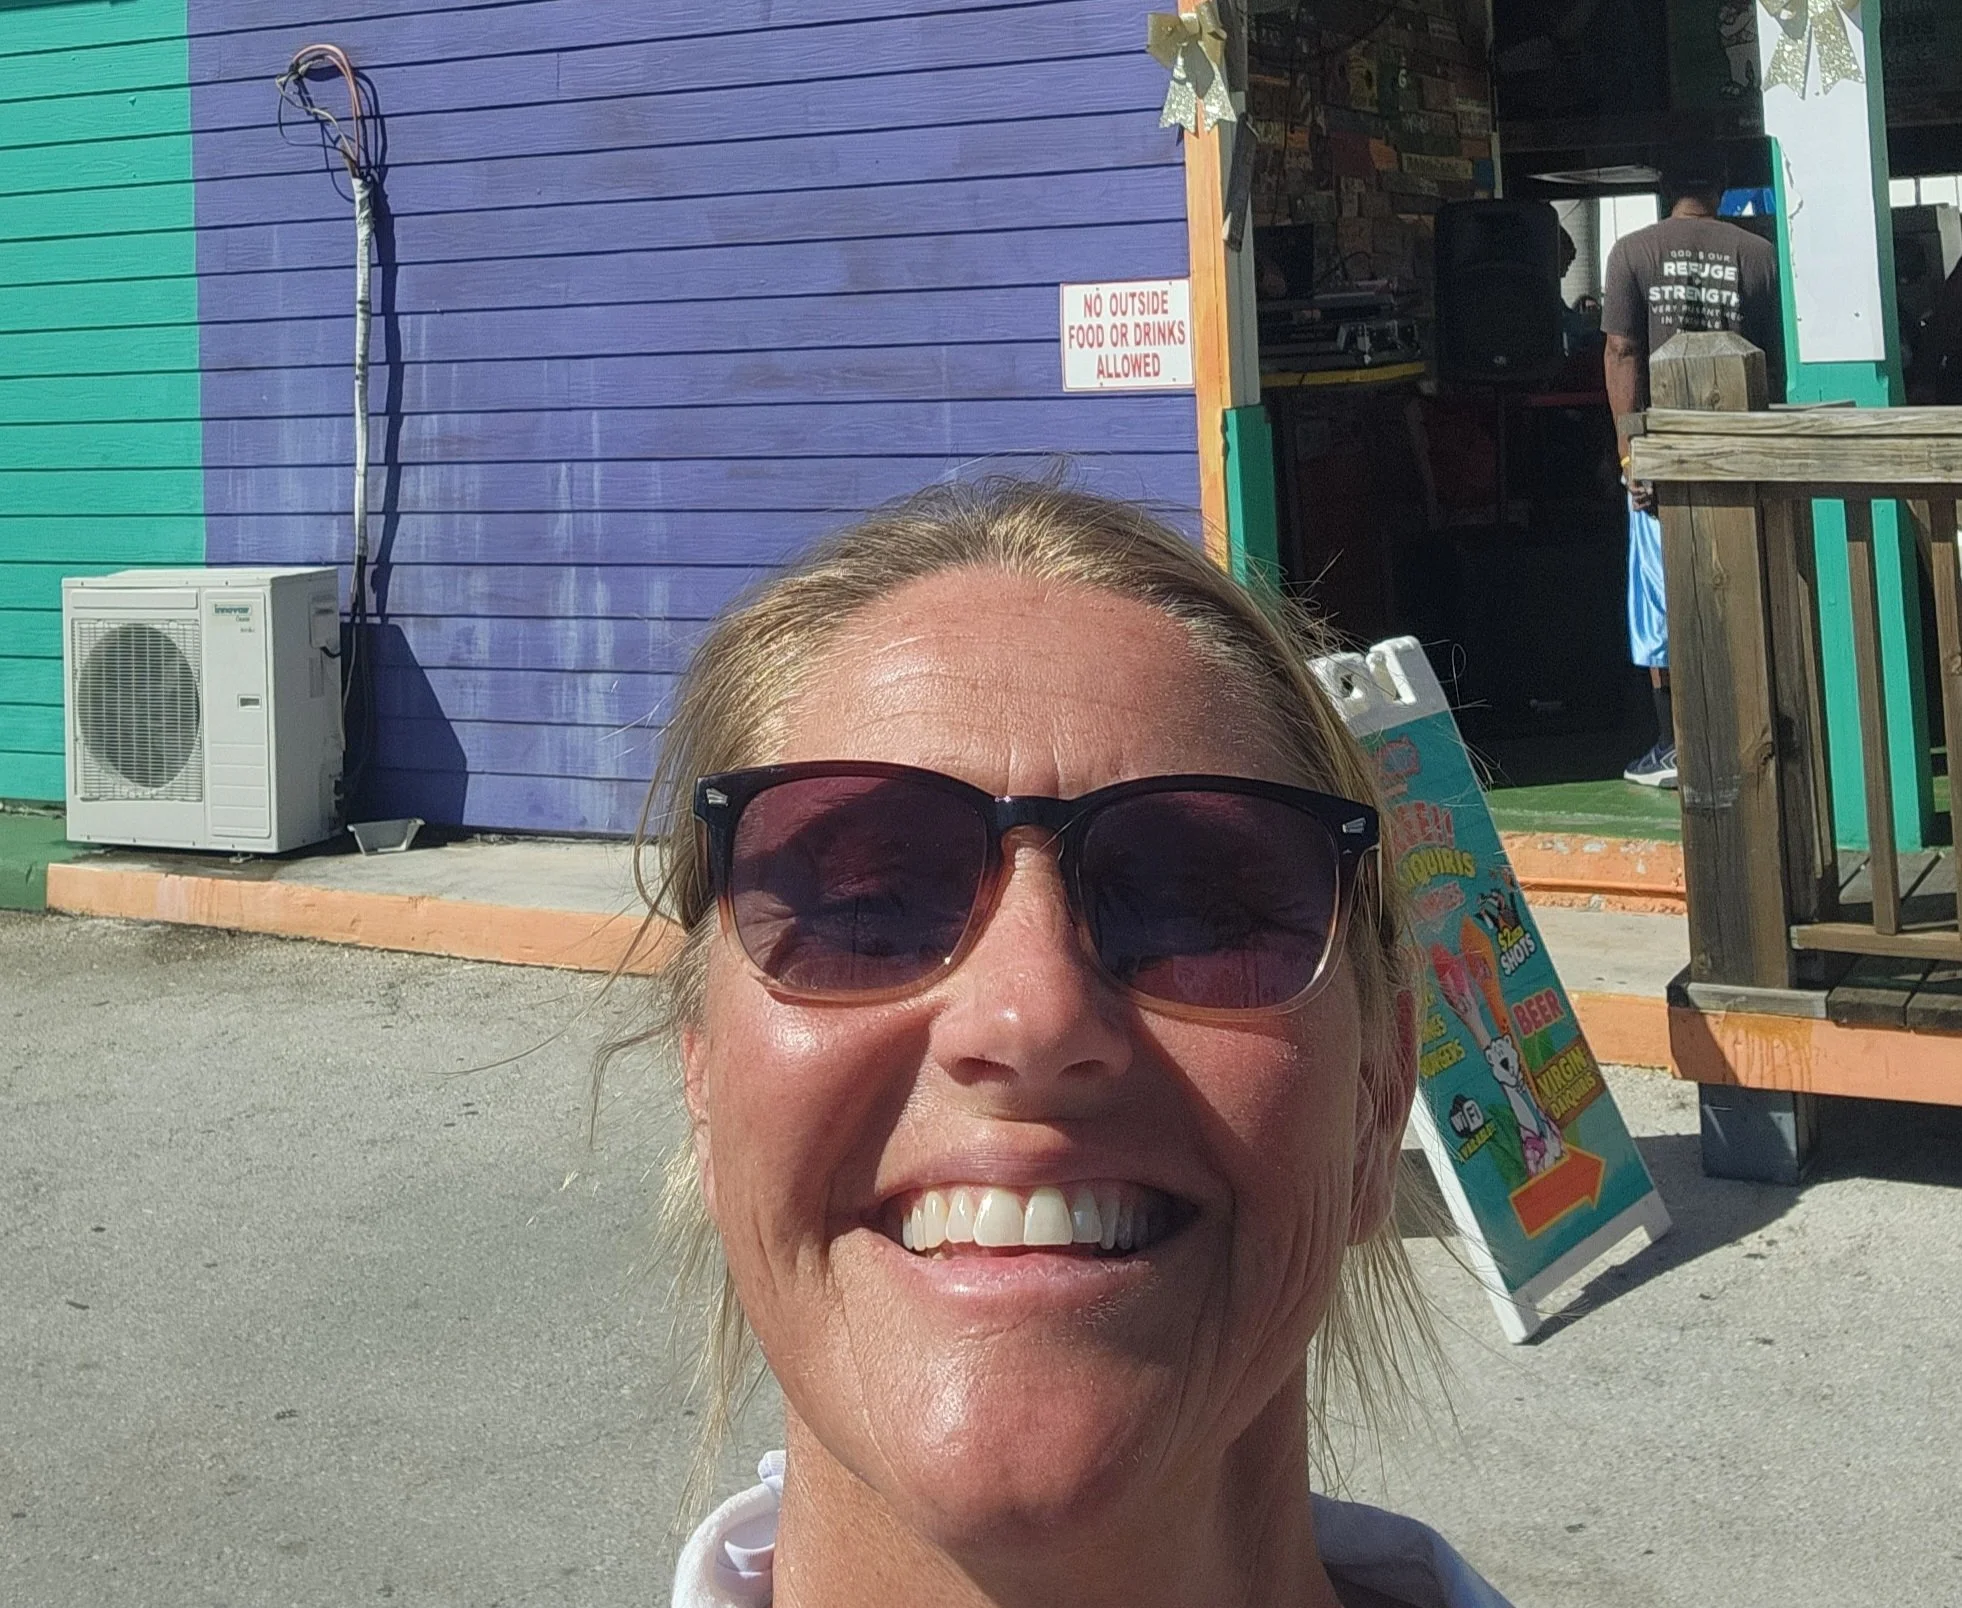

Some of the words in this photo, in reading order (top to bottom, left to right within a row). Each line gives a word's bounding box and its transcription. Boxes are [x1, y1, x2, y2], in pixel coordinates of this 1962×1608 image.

[1670, 249, 1692, 258] GOD
[1708, 252, 1730, 261] OUR
[1663, 261, 1737, 281] REFUGE
[1084, 293, 1102, 318] NO
[1109, 290, 1168, 317] OUTSIDE
[1648, 285, 1740, 307] STRENGTH
[1068, 324, 1104, 349] FOOD
[1110, 323, 1129, 347] OR
[1134, 320, 1186, 346] DRINKS
[1660, 316, 1673, 325] IN
[1097, 353, 1161, 379] ALLOWED
[1500, 932, 1536, 976] SHOTS
[1513, 988, 1564, 1036] BEER
[1537, 1045, 1588, 1098] VIRGIN
[1550, 1071, 1597, 1121] DAIQUIRIS
